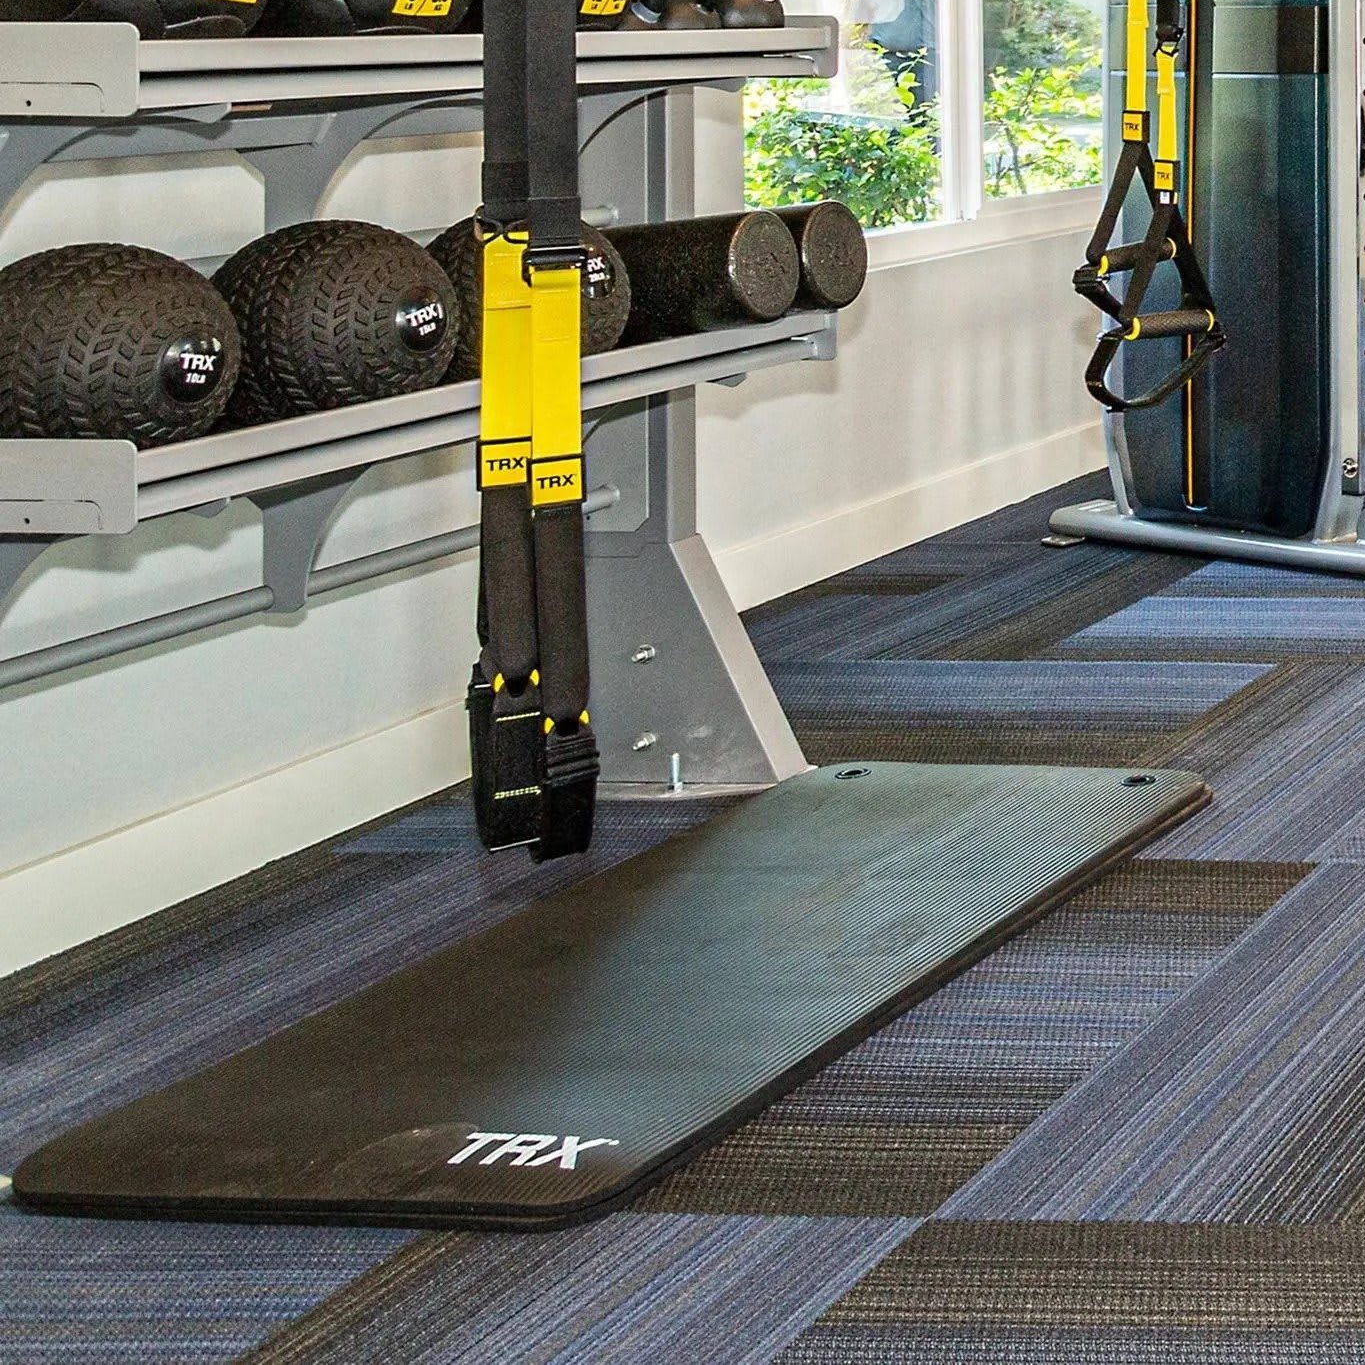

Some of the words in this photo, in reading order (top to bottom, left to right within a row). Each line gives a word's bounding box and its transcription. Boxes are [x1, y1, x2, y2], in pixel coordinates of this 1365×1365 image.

[1124, 122, 1140, 131] TRX
[1157, 171, 1170, 180] TRX
[587, 256, 605, 272] RX
[405, 303, 438, 326] TRX
[180, 353, 217, 371] TRX
[486, 456, 525, 472] TRX
[536, 474, 574, 489] TRX
[447, 1132, 615, 1170] TRX
